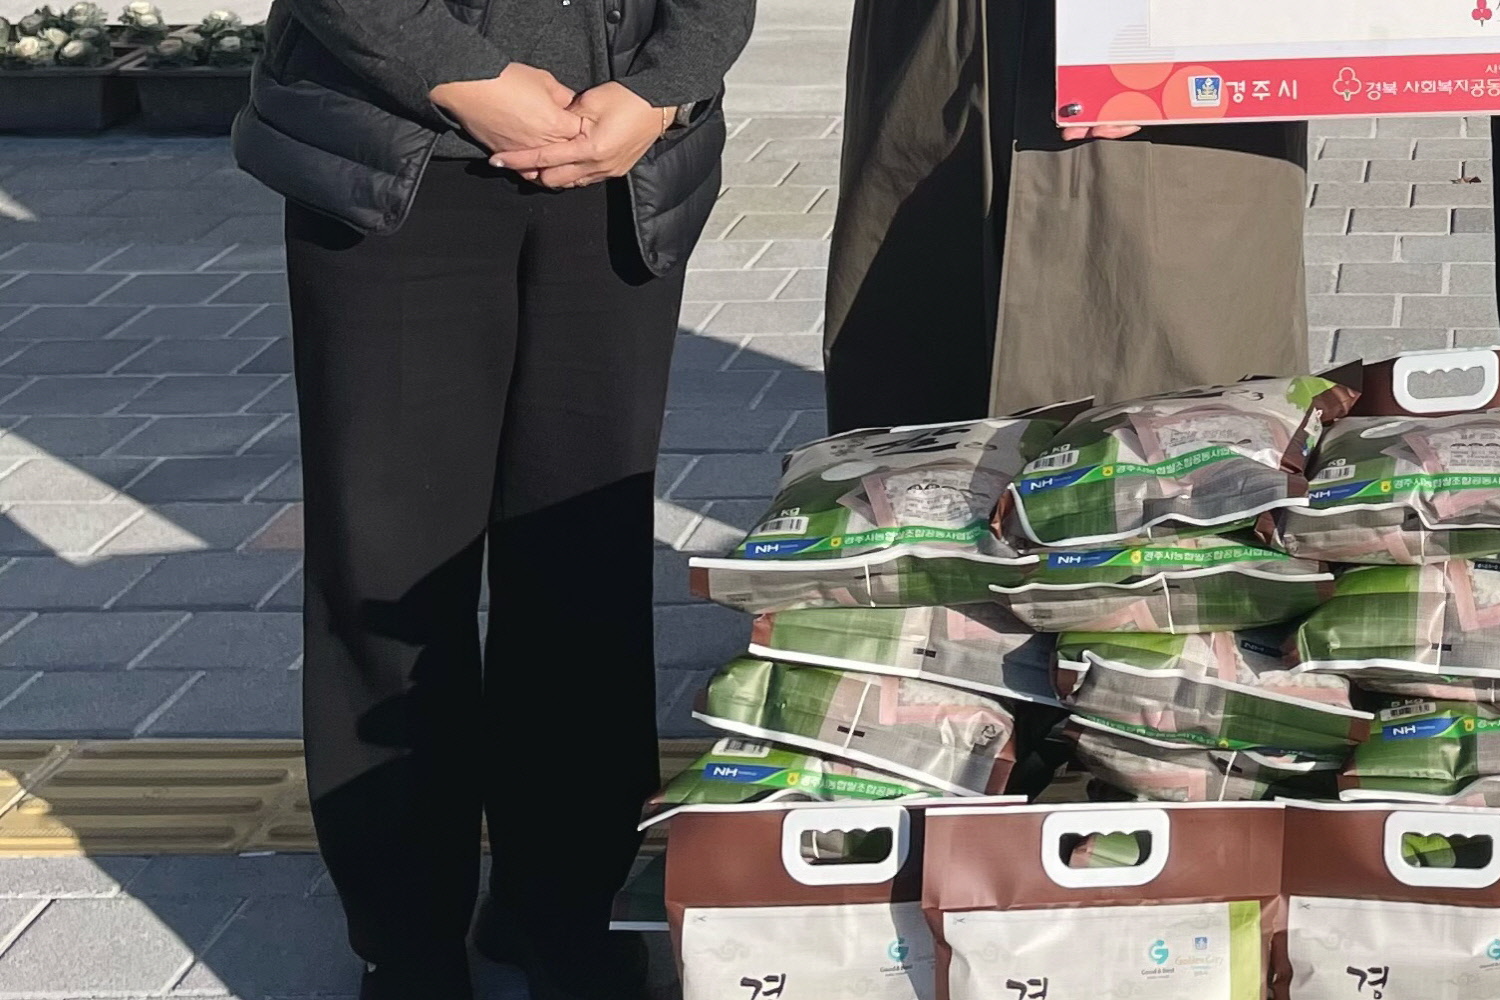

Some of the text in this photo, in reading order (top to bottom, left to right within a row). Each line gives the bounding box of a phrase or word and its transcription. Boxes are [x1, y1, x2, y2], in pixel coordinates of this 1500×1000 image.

[1225, 79, 1298, 104] 경주시
[1365, 80, 1398, 101] 경북
[1030, 478, 1053, 491] NH
[754, 544, 779, 554] NH
[1057, 555, 1082, 565] NH
[1392, 725, 1417, 736] NH
[713, 766, 739, 777] NH
